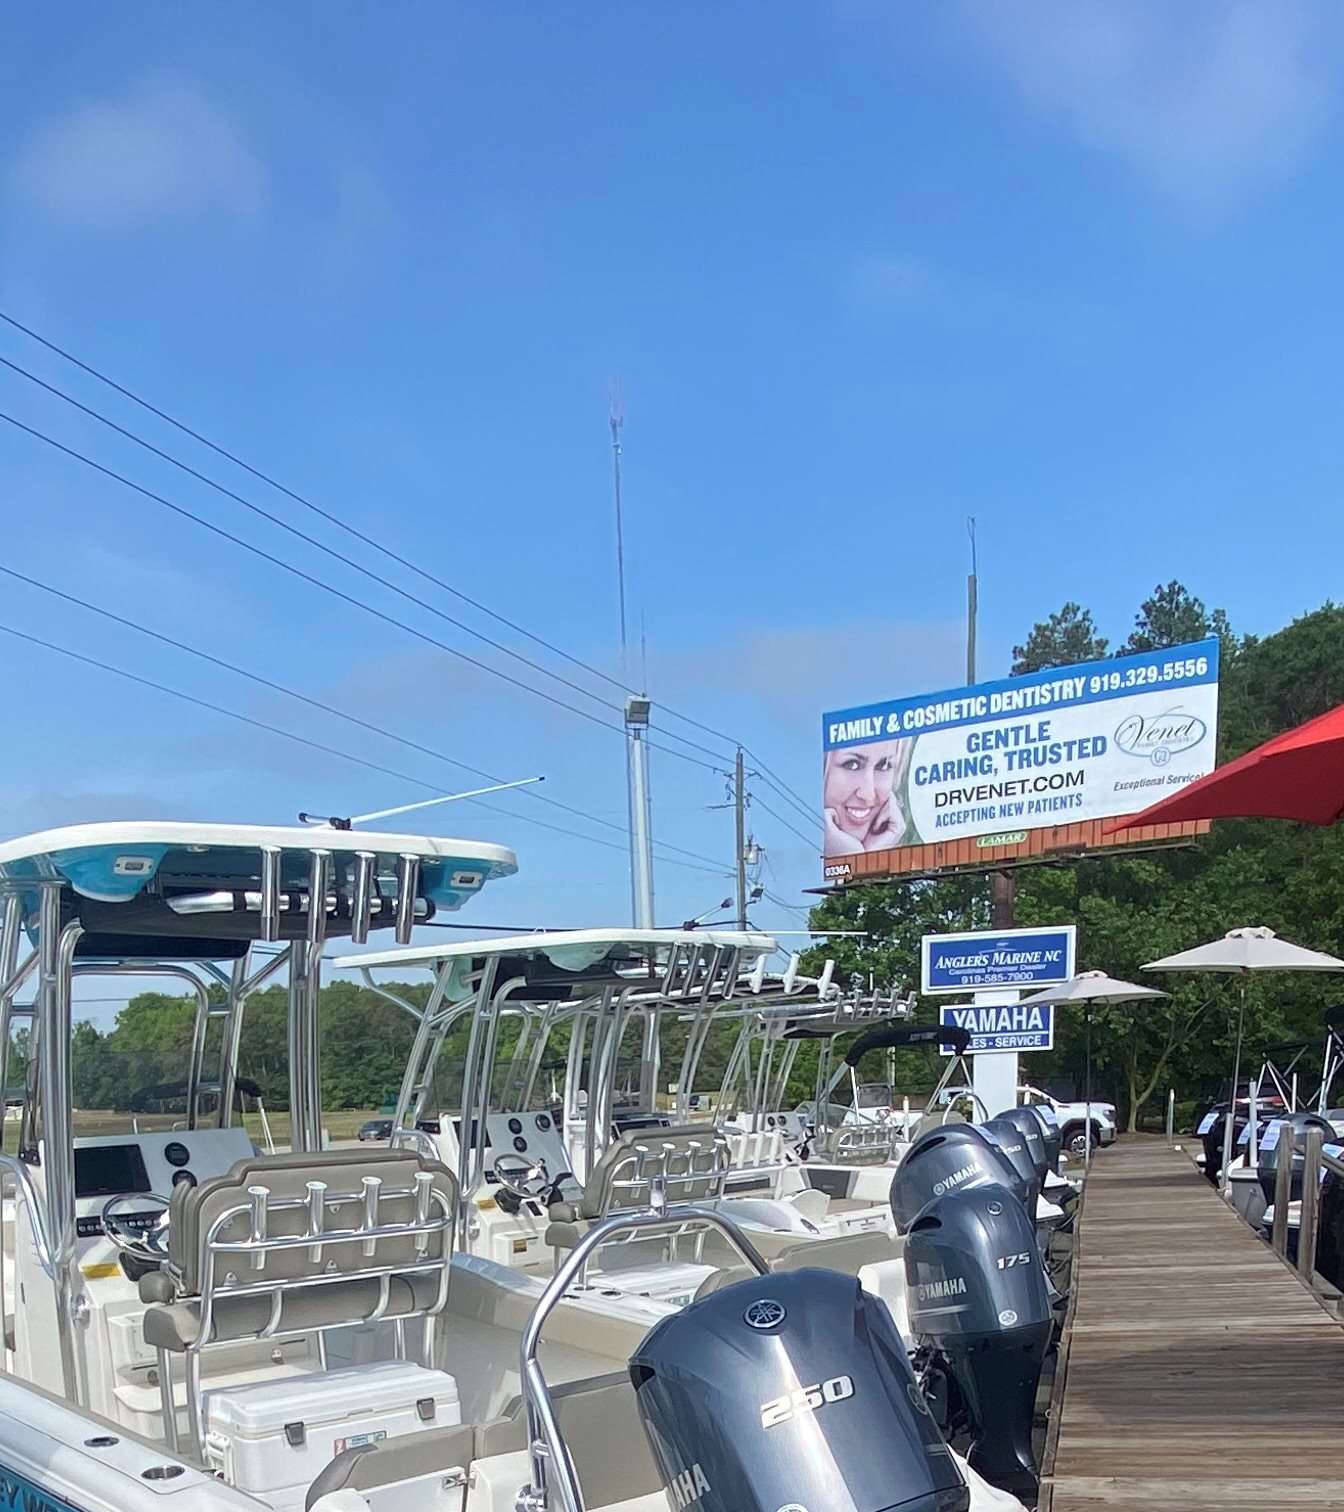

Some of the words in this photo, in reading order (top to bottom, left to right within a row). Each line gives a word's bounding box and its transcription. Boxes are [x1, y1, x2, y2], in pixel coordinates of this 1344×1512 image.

[829, 715, 884, 744] FAMILY
[886, 713, 900, 733] &
[903, 695, 987, 730] COSMETIC
[990, 676, 1086, 714] DENTISTRY
[1090, 657, 1208, 693] 919.329.5556
[966, 720, 1051, 753] GENTLE
[914, 754, 999, 786] CARING,
[1004, 735, 1107, 772] TRUSTED
[934, 769, 1085, 808] DRVENET.COM
[1113, 775, 1165, 792] Exceptional
[935, 806, 996, 828] ACCEPTING
[999, 802, 1025, 818] NEW
[1028, 793, 1083, 814] PATIENTS
[980, 833, 1023, 846] LAMAR
[935, 953, 989, 969] ANGLERS
[992, 951, 1042, 966] MARINE
[1044, 950, 1062, 962] NC
[961, 972, 1034, 984] 919-585-7900
[952, 1007, 1044, 1033] YAMAHA
[995, 1035, 1042, 1048] SERVICE
[942, 1162, 983, 1190] YAMAHA
[996, 1252, 1031, 1271] 175
[924, 1277, 967, 1300] YAMAHA
[760, 1375, 855, 1430] 250
